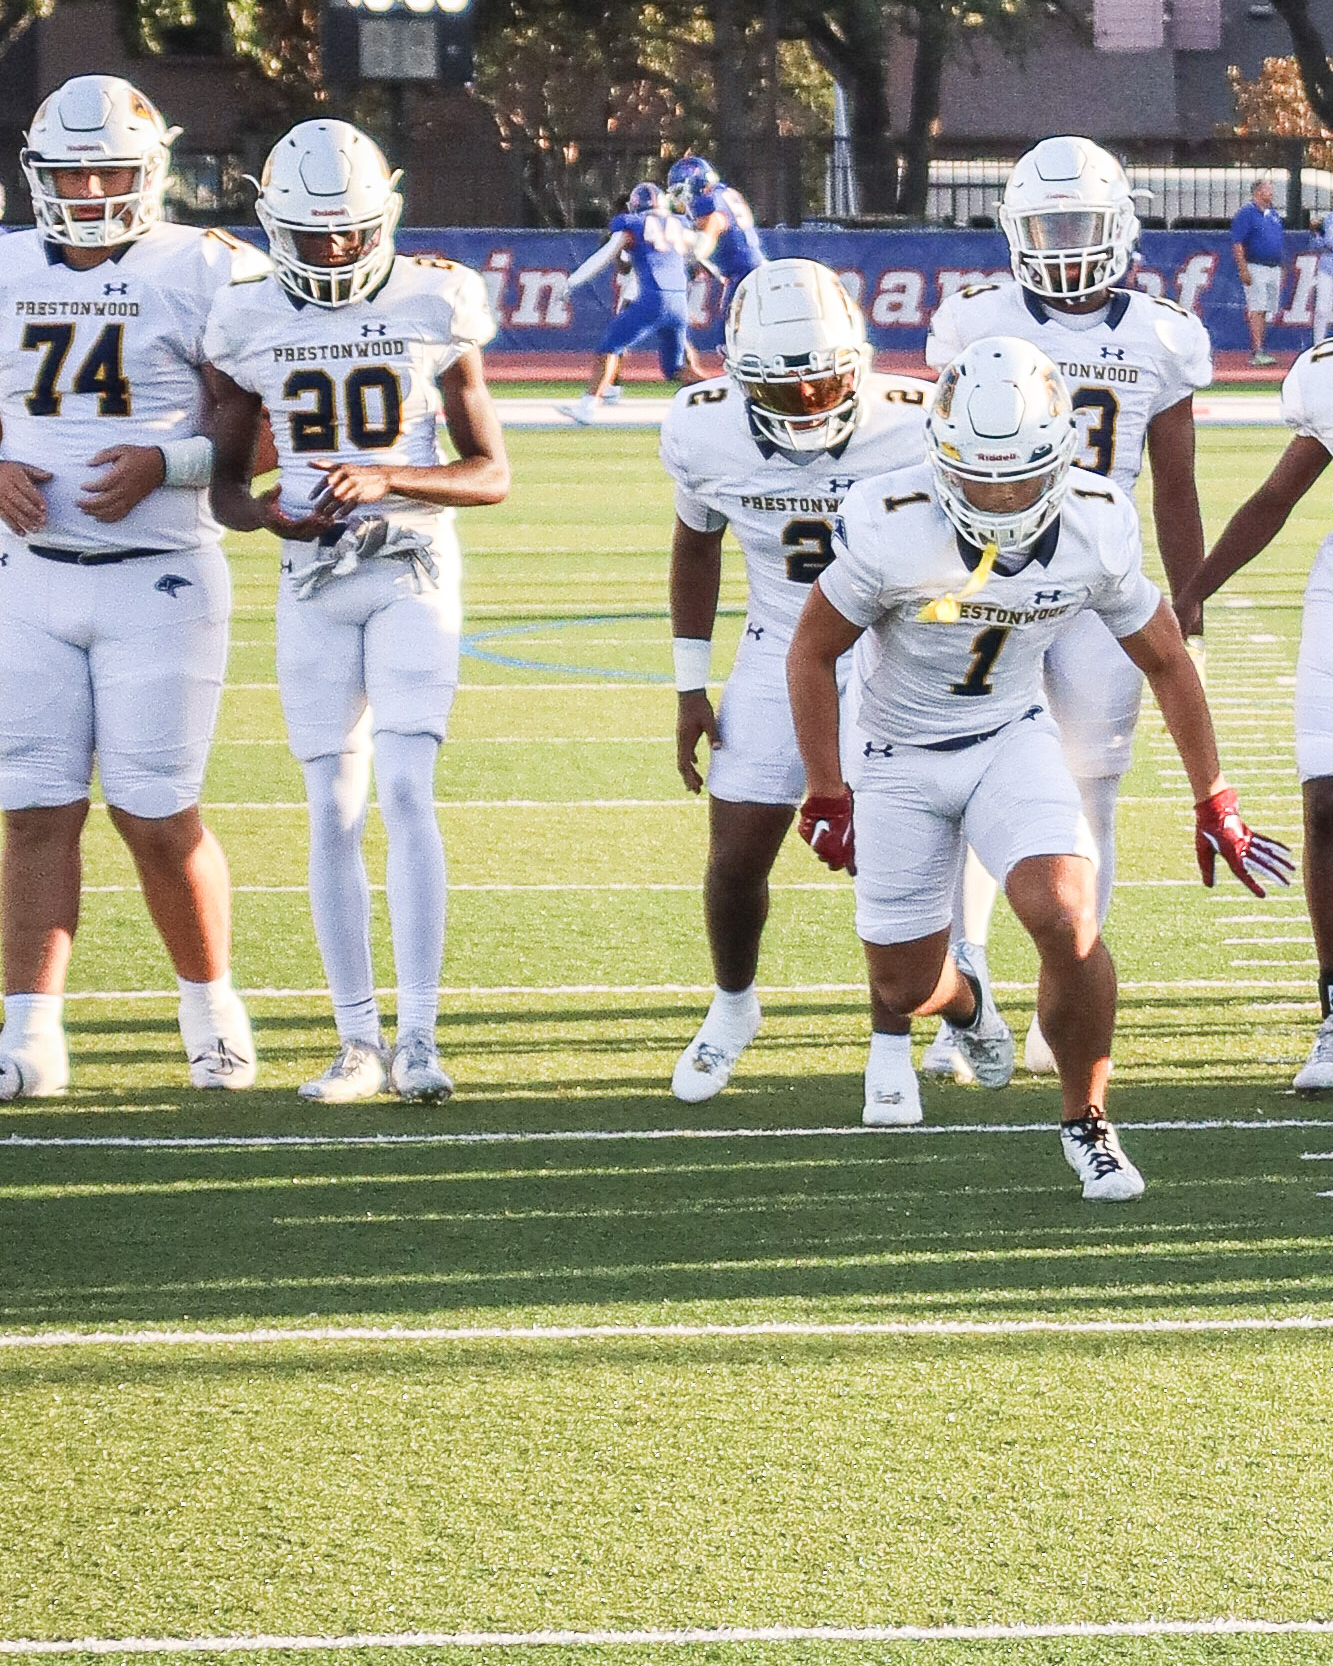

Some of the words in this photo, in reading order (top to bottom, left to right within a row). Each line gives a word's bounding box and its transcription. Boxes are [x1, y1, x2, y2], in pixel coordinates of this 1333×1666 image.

[15, 301, 140, 317] PRESTONWOOD
[20, 322, 132, 417] 74
[274, 340, 405, 363] PRESTONWOOD
[282, 363, 404, 453] 20
[686, 387, 728, 407] 2
[1069, 385, 1121, 477] 3
[781, 517, 838, 583] 2
[951, 624, 1012, 697] 1
